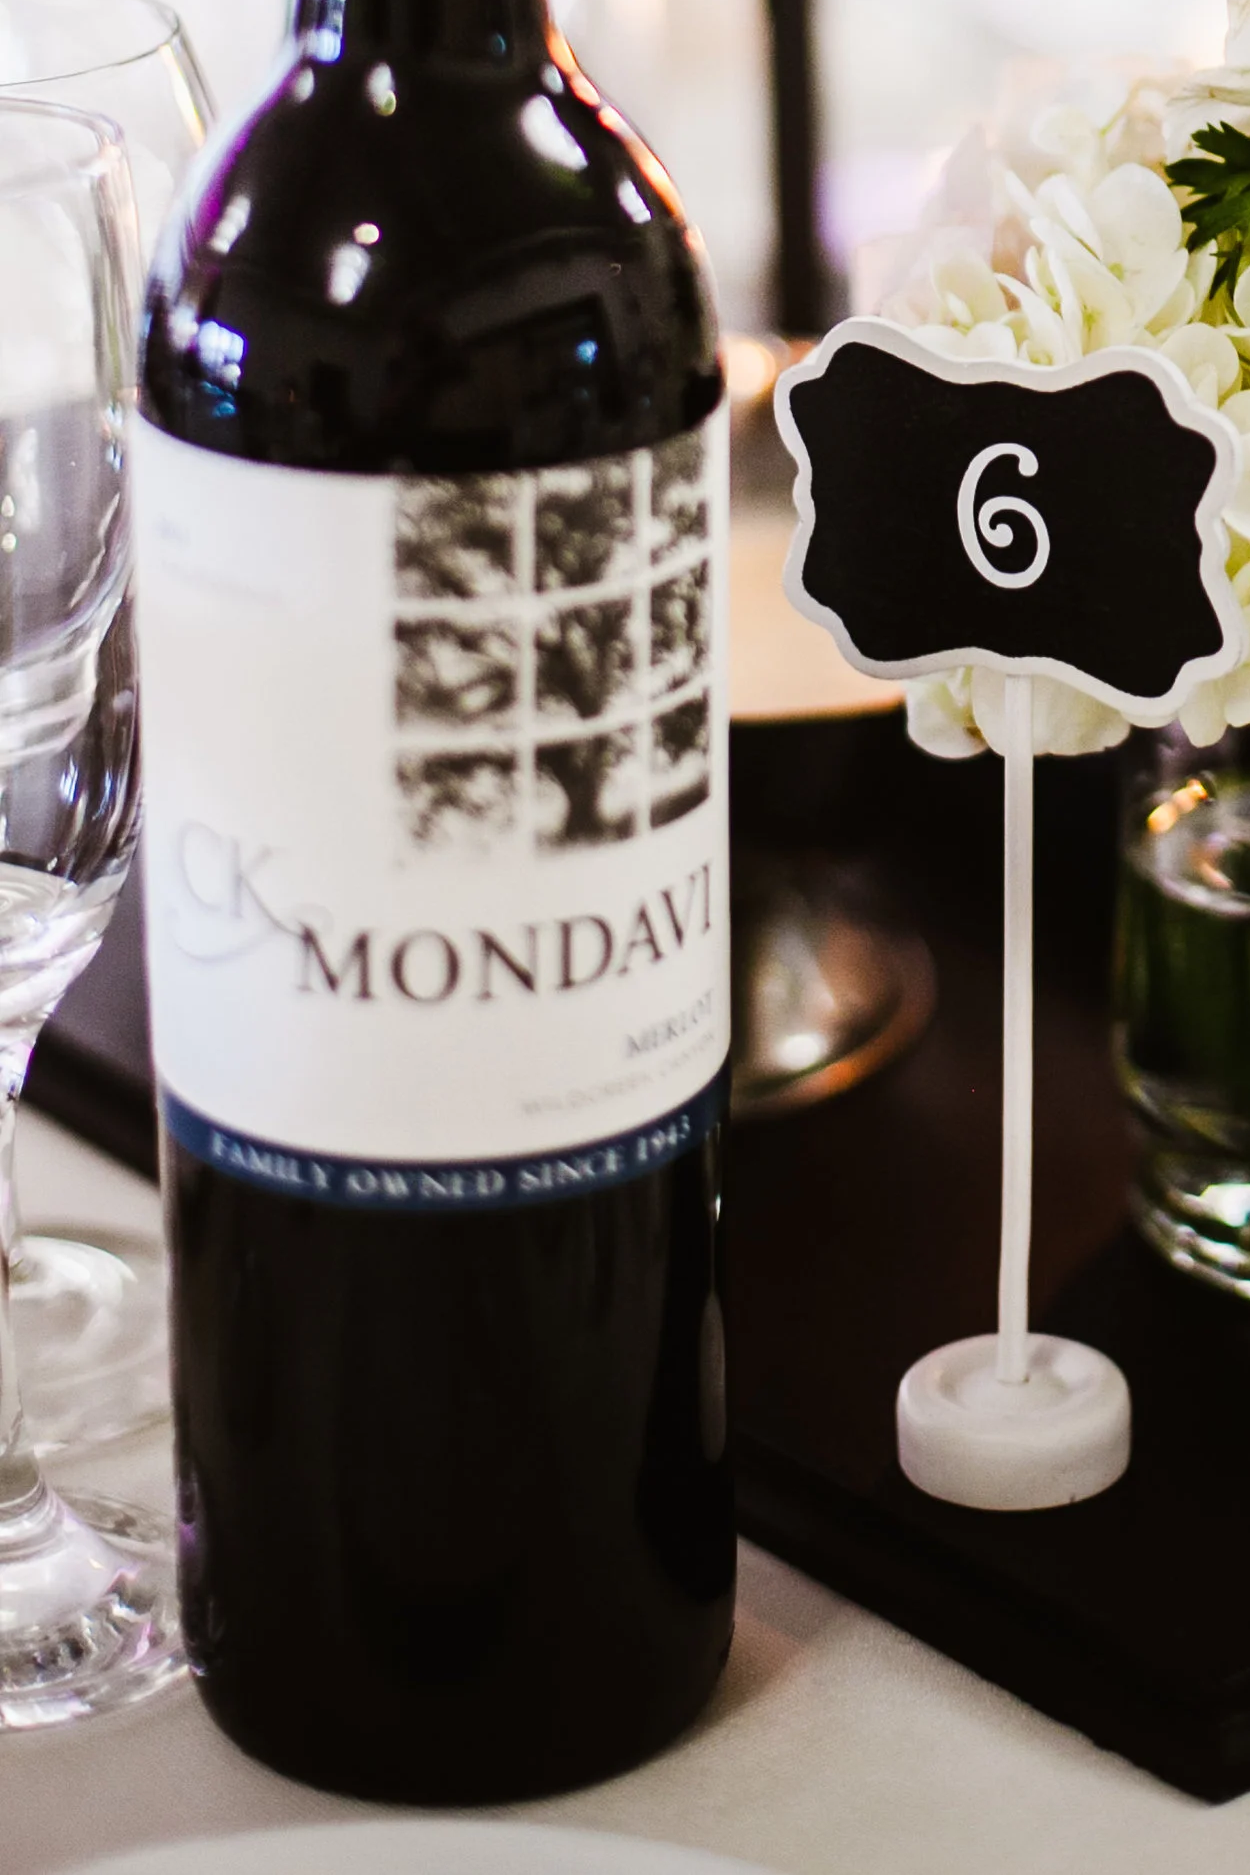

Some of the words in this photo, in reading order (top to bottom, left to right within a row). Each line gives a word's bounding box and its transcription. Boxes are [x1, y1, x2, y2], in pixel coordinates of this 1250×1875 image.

[956, 442, 1051, 590] 6
[296, 859, 713, 1003] MONDAVI
[625, 988, 714, 1059] MERLOT
[210, 1131, 331, 1191] FAMILY
[346, 1167, 506, 1199] OWNED
[516, 1144, 624, 1192] SINCE
[637, 1114, 691, 1162] 1943
